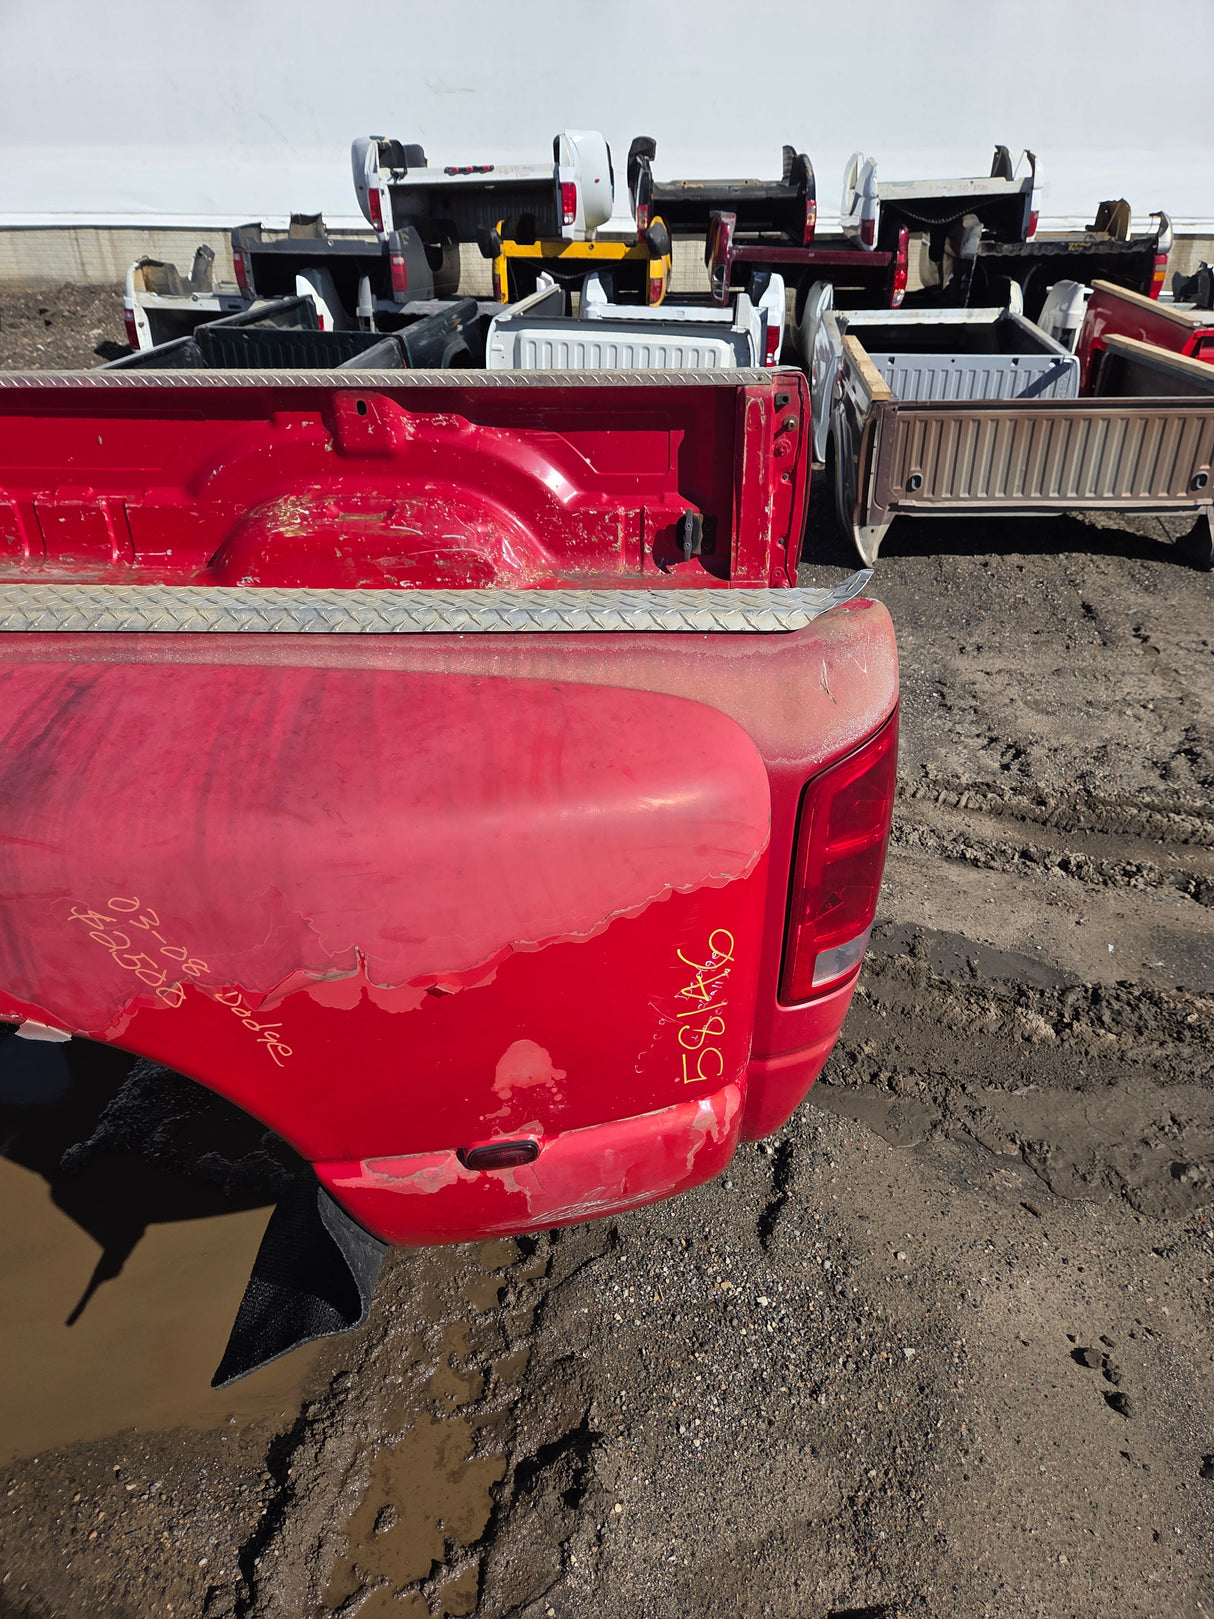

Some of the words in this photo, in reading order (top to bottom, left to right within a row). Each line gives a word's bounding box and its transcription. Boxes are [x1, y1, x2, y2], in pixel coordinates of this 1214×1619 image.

[107, 896, 211, 977] 03-08
[214, 991, 293, 1067] Dodge
[676, 928, 735, 1084] 58146
